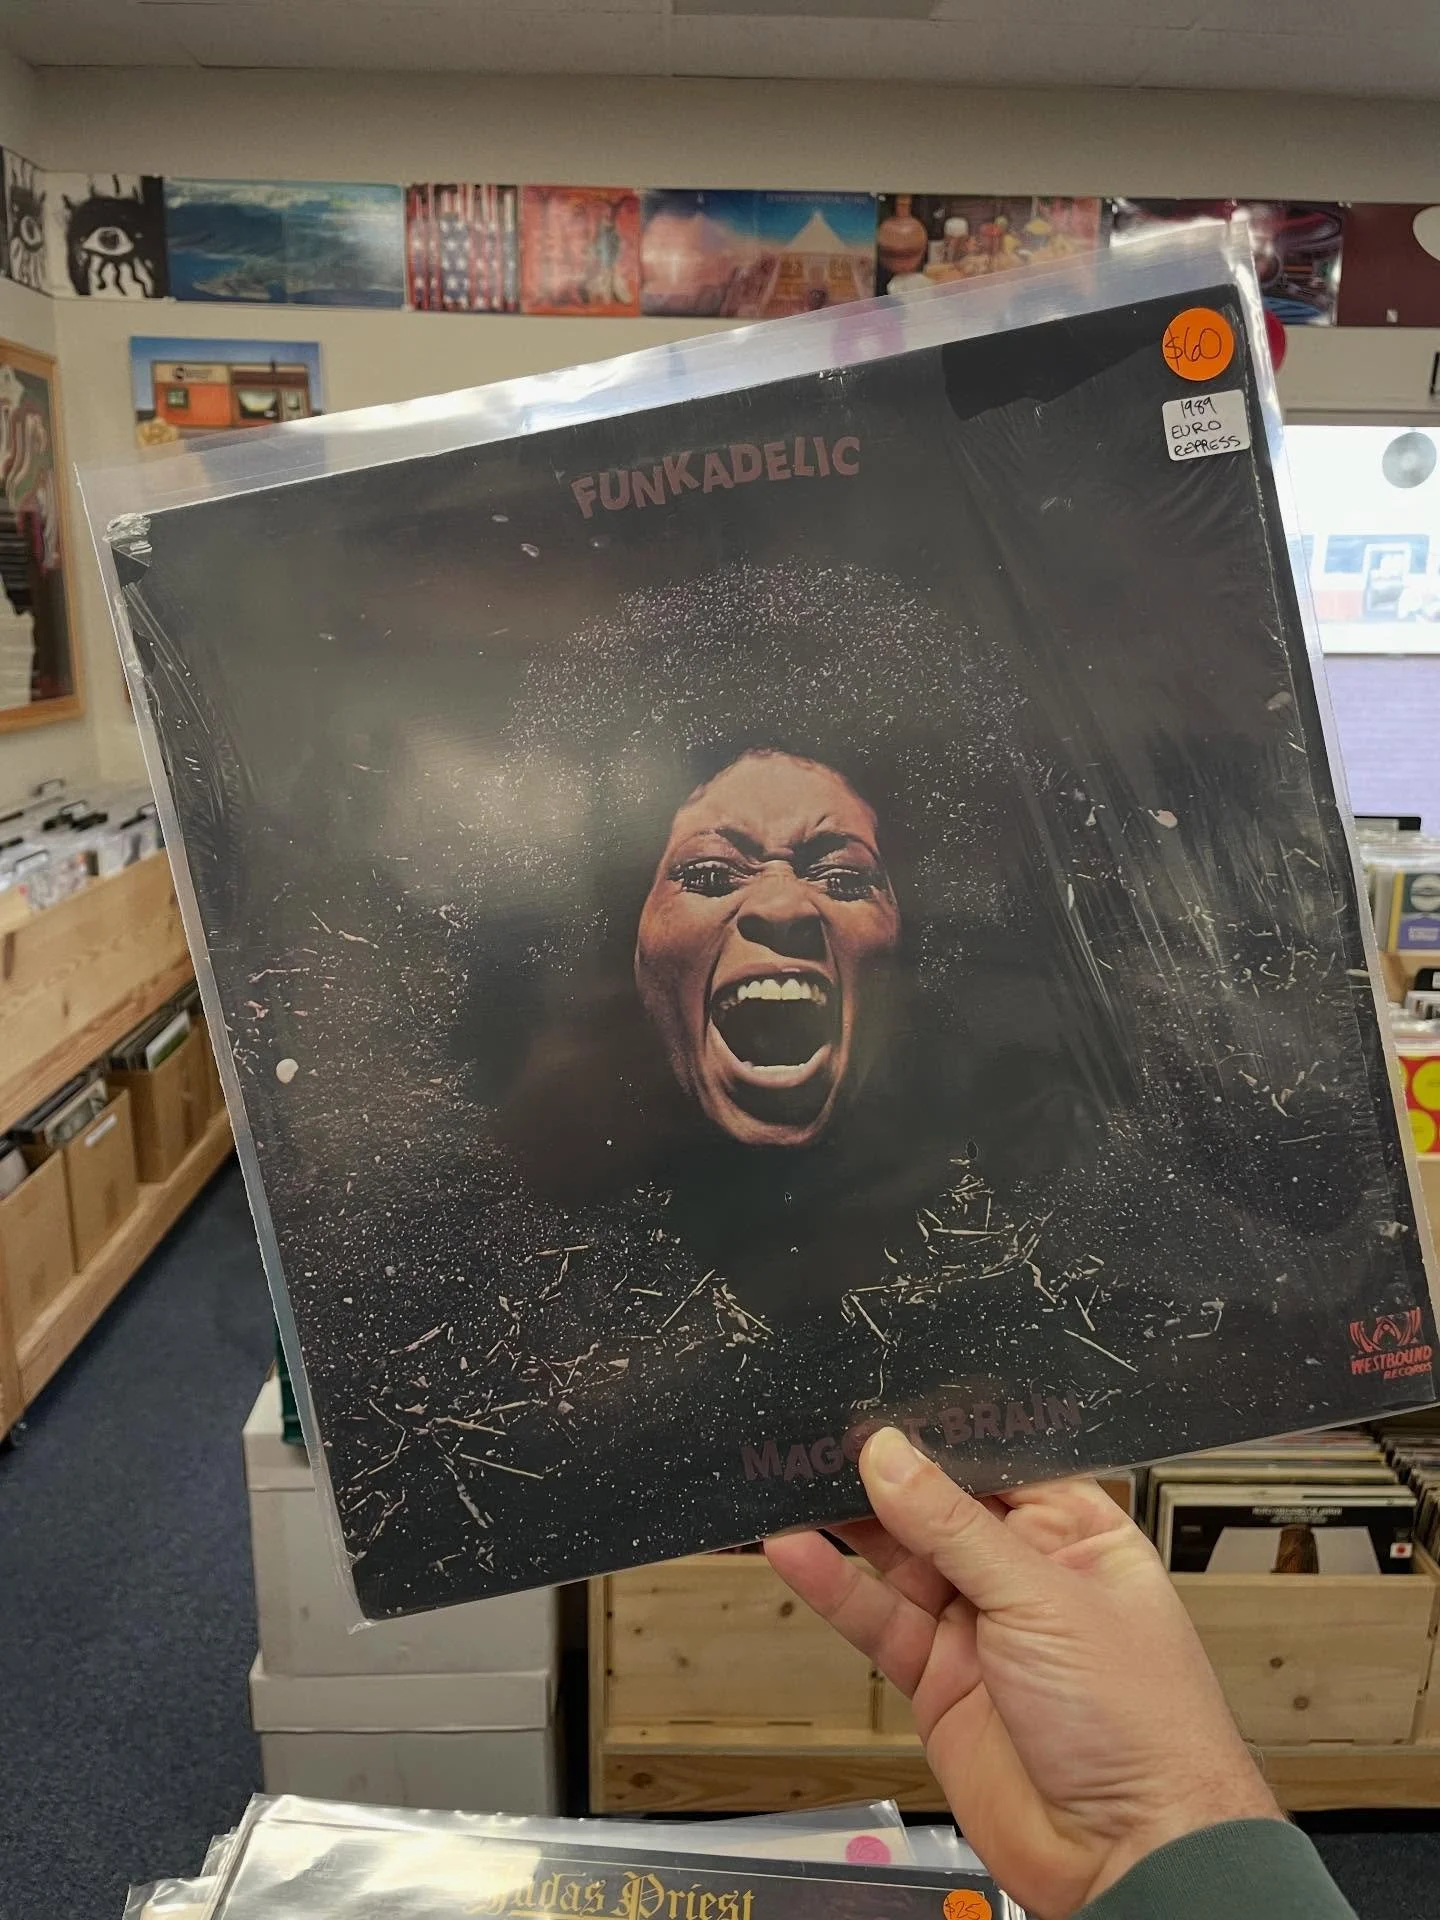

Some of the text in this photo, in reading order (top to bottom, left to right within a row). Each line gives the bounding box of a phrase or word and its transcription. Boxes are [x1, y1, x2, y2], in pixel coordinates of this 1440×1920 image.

[1164, 327, 1222, 371] $60
[1181, 397, 1217, 419] 1989
[1171, 420, 1222, 439] EURO
[1174, 435, 1241, 457] REPRESS
[571, 436, 861, 519] FUNKADELIC
[1351, 1345, 1433, 1376] WESTBOUND
[740, 1391, 1083, 1482] MAGGT BRAIN
[610, 1871, 756, 1920] Priest
[944, 1899, 981, 1920] $25
